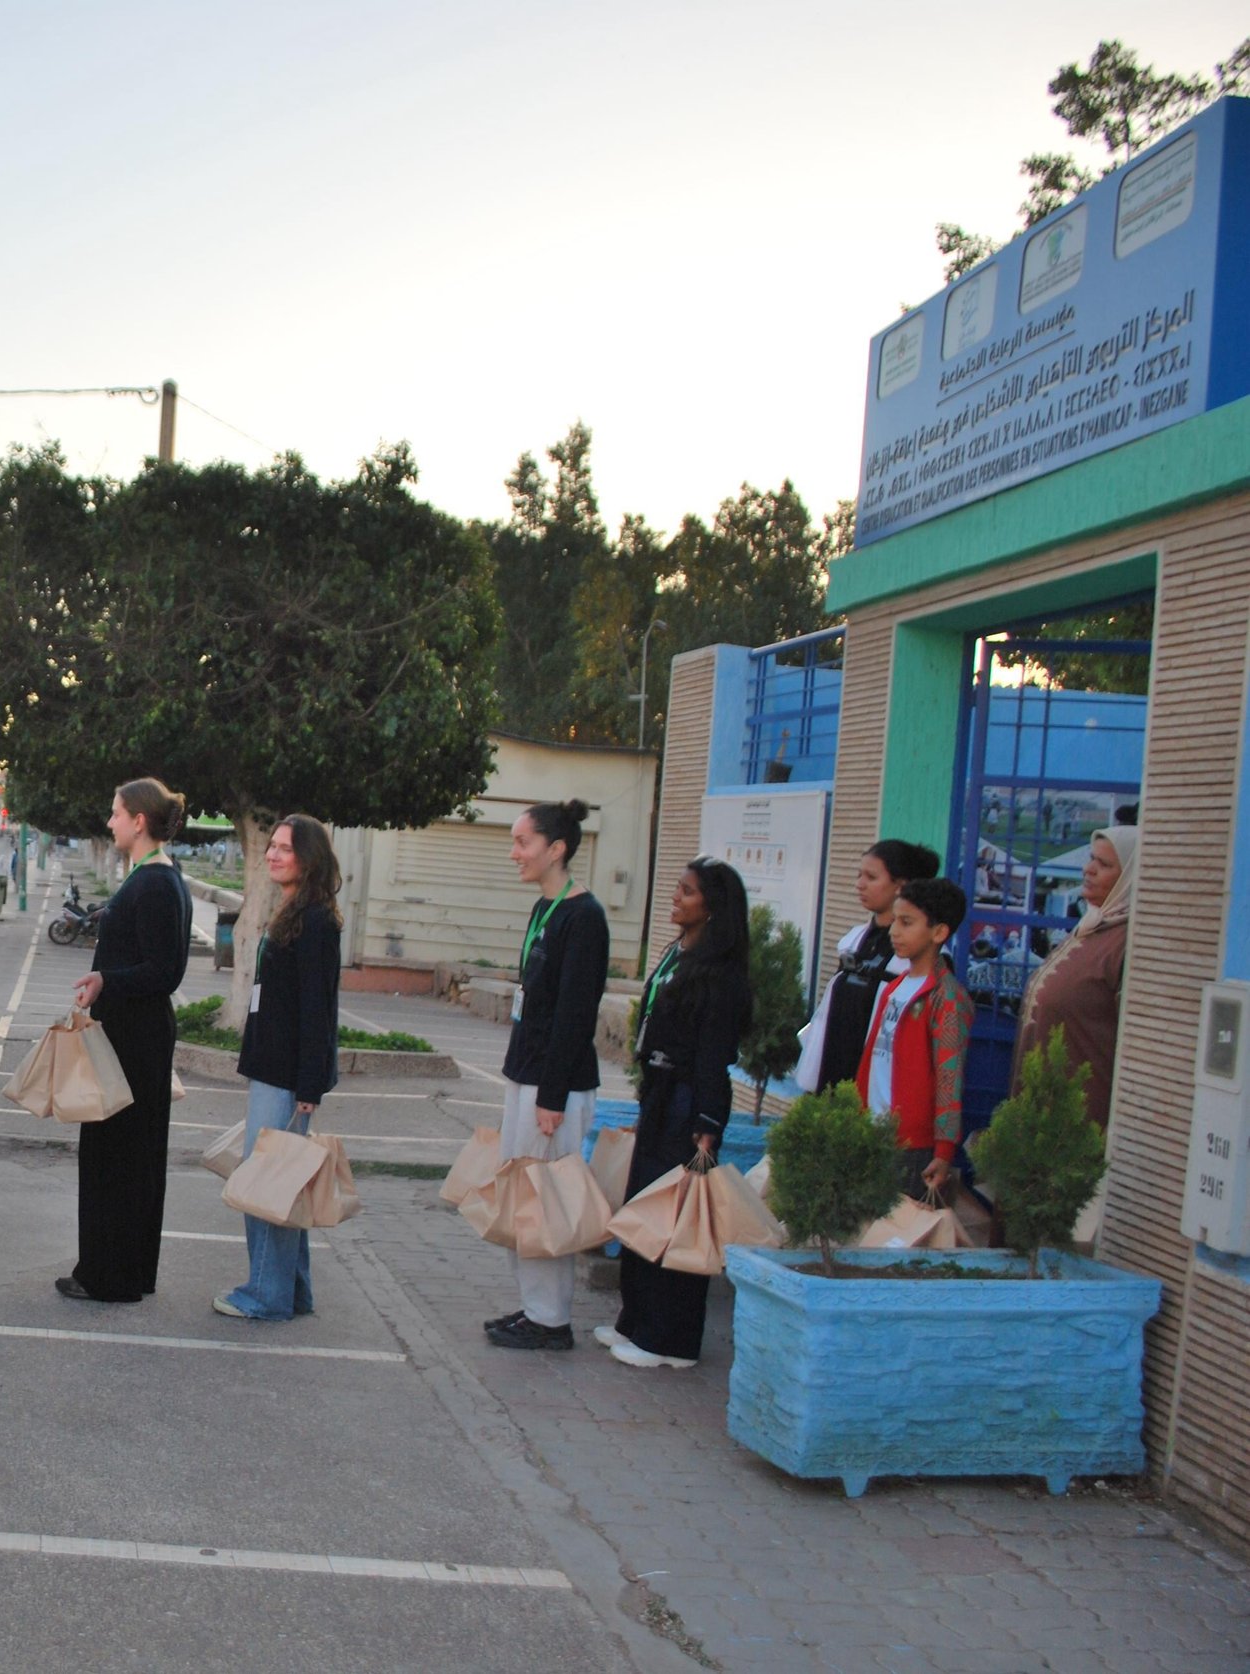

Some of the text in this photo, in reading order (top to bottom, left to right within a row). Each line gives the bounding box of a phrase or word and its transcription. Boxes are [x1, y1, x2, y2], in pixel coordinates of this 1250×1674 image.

[988, 326, 1024, 367] الرعاية
[1025, 302, 1076, 344] مؤسسة
[1085, 316, 1140, 375] التربوي
[1141, 289, 1195, 353] المركز
[939, 346, 988, 394] الاجتماعية
[1024, 344, 1084, 404] التأهيلي
[950, 403, 969, 439] في
[971, 374, 1024, 428] للأشخاص
[918, 418, 950, 456] وضعية
[965, 466, 978, 491] DES
[978, 448, 1020, 484] PERSONNES
[1020, 444, 1031, 469] EN
[1031, 424, 1079, 465] SITUATIONS
[1139, 378, 1189, 421] INEZGANE
